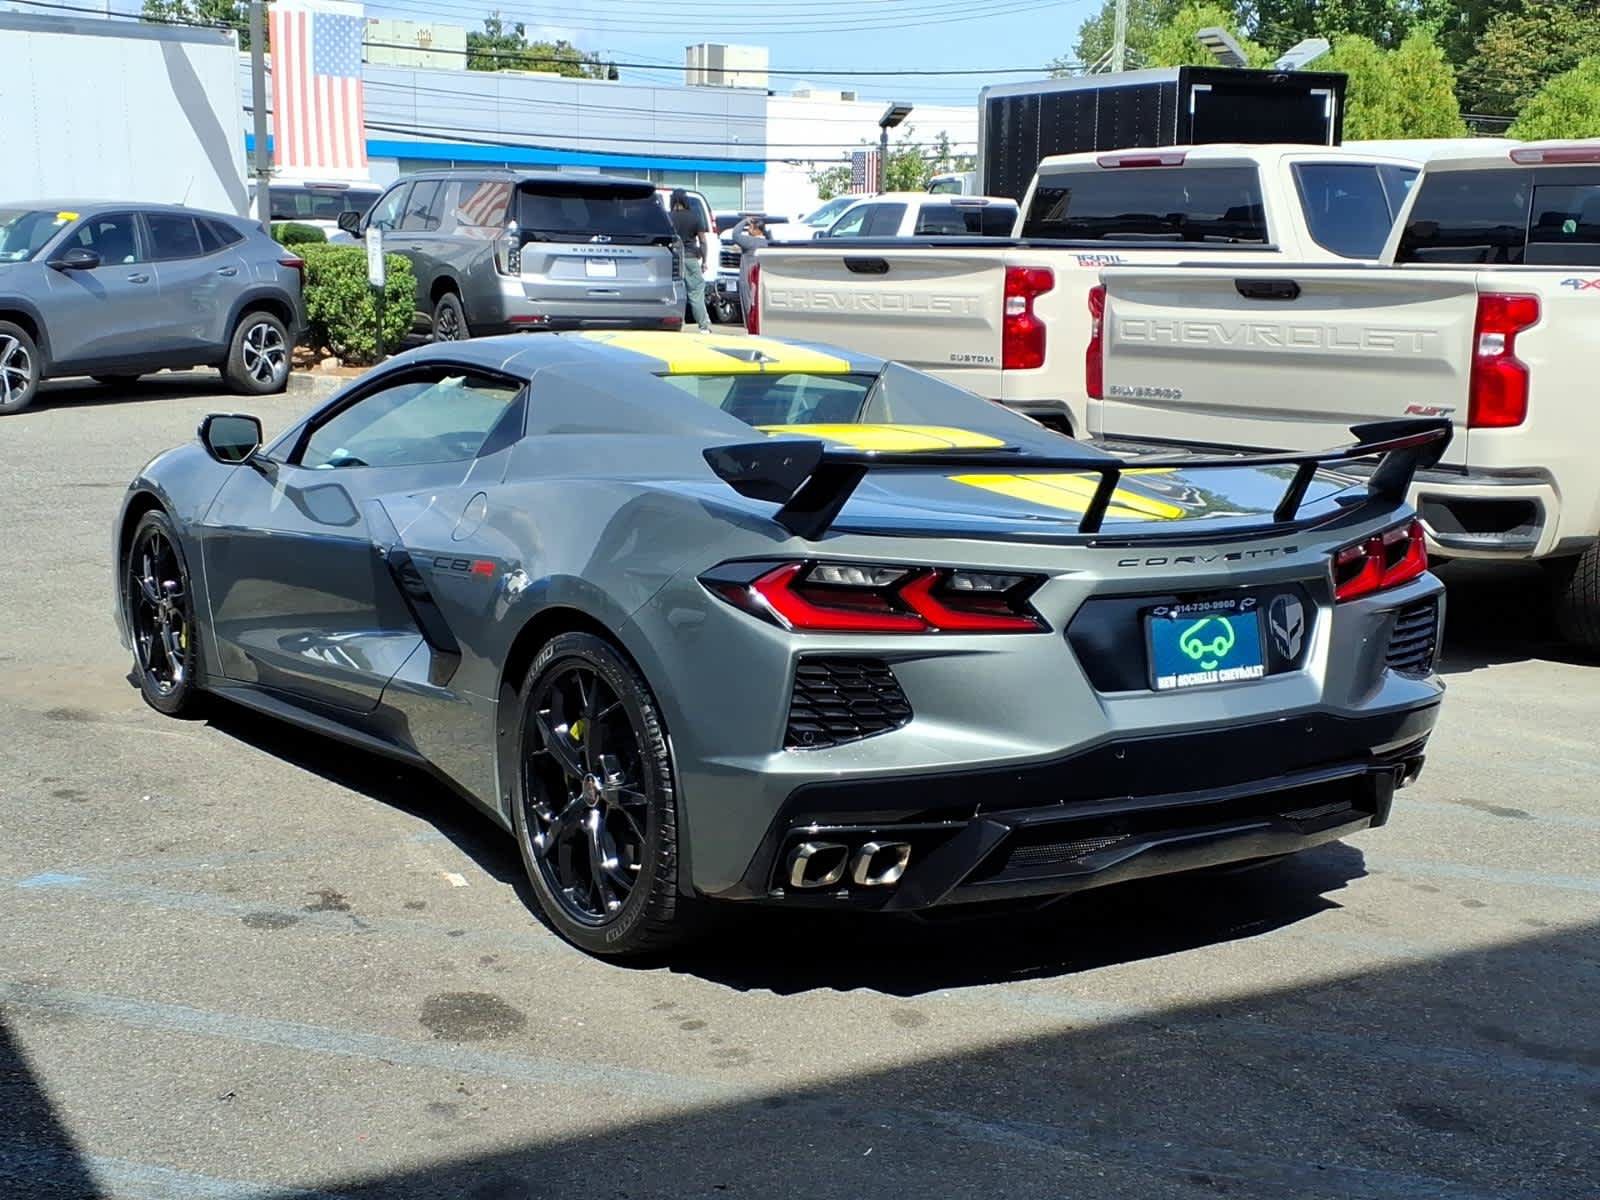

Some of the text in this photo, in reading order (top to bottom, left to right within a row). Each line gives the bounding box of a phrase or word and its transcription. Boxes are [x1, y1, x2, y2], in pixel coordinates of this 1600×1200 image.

[1068, 254, 1128, 264] TRAIL
[768, 289, 982, 314] CHEVROLET
[1119, 320, 1438, 353] CHEVROLET
[950, 353, 994, 363] CUSTOM
[1109, 384, 1183, 399] SILVERADO
[1403, 405, 1456, 416] RST
[1117, 546, 1299, 567] CORVETTE
[1157, 664, 1265, 689] NEW ROCHELLE CHEVROLET
